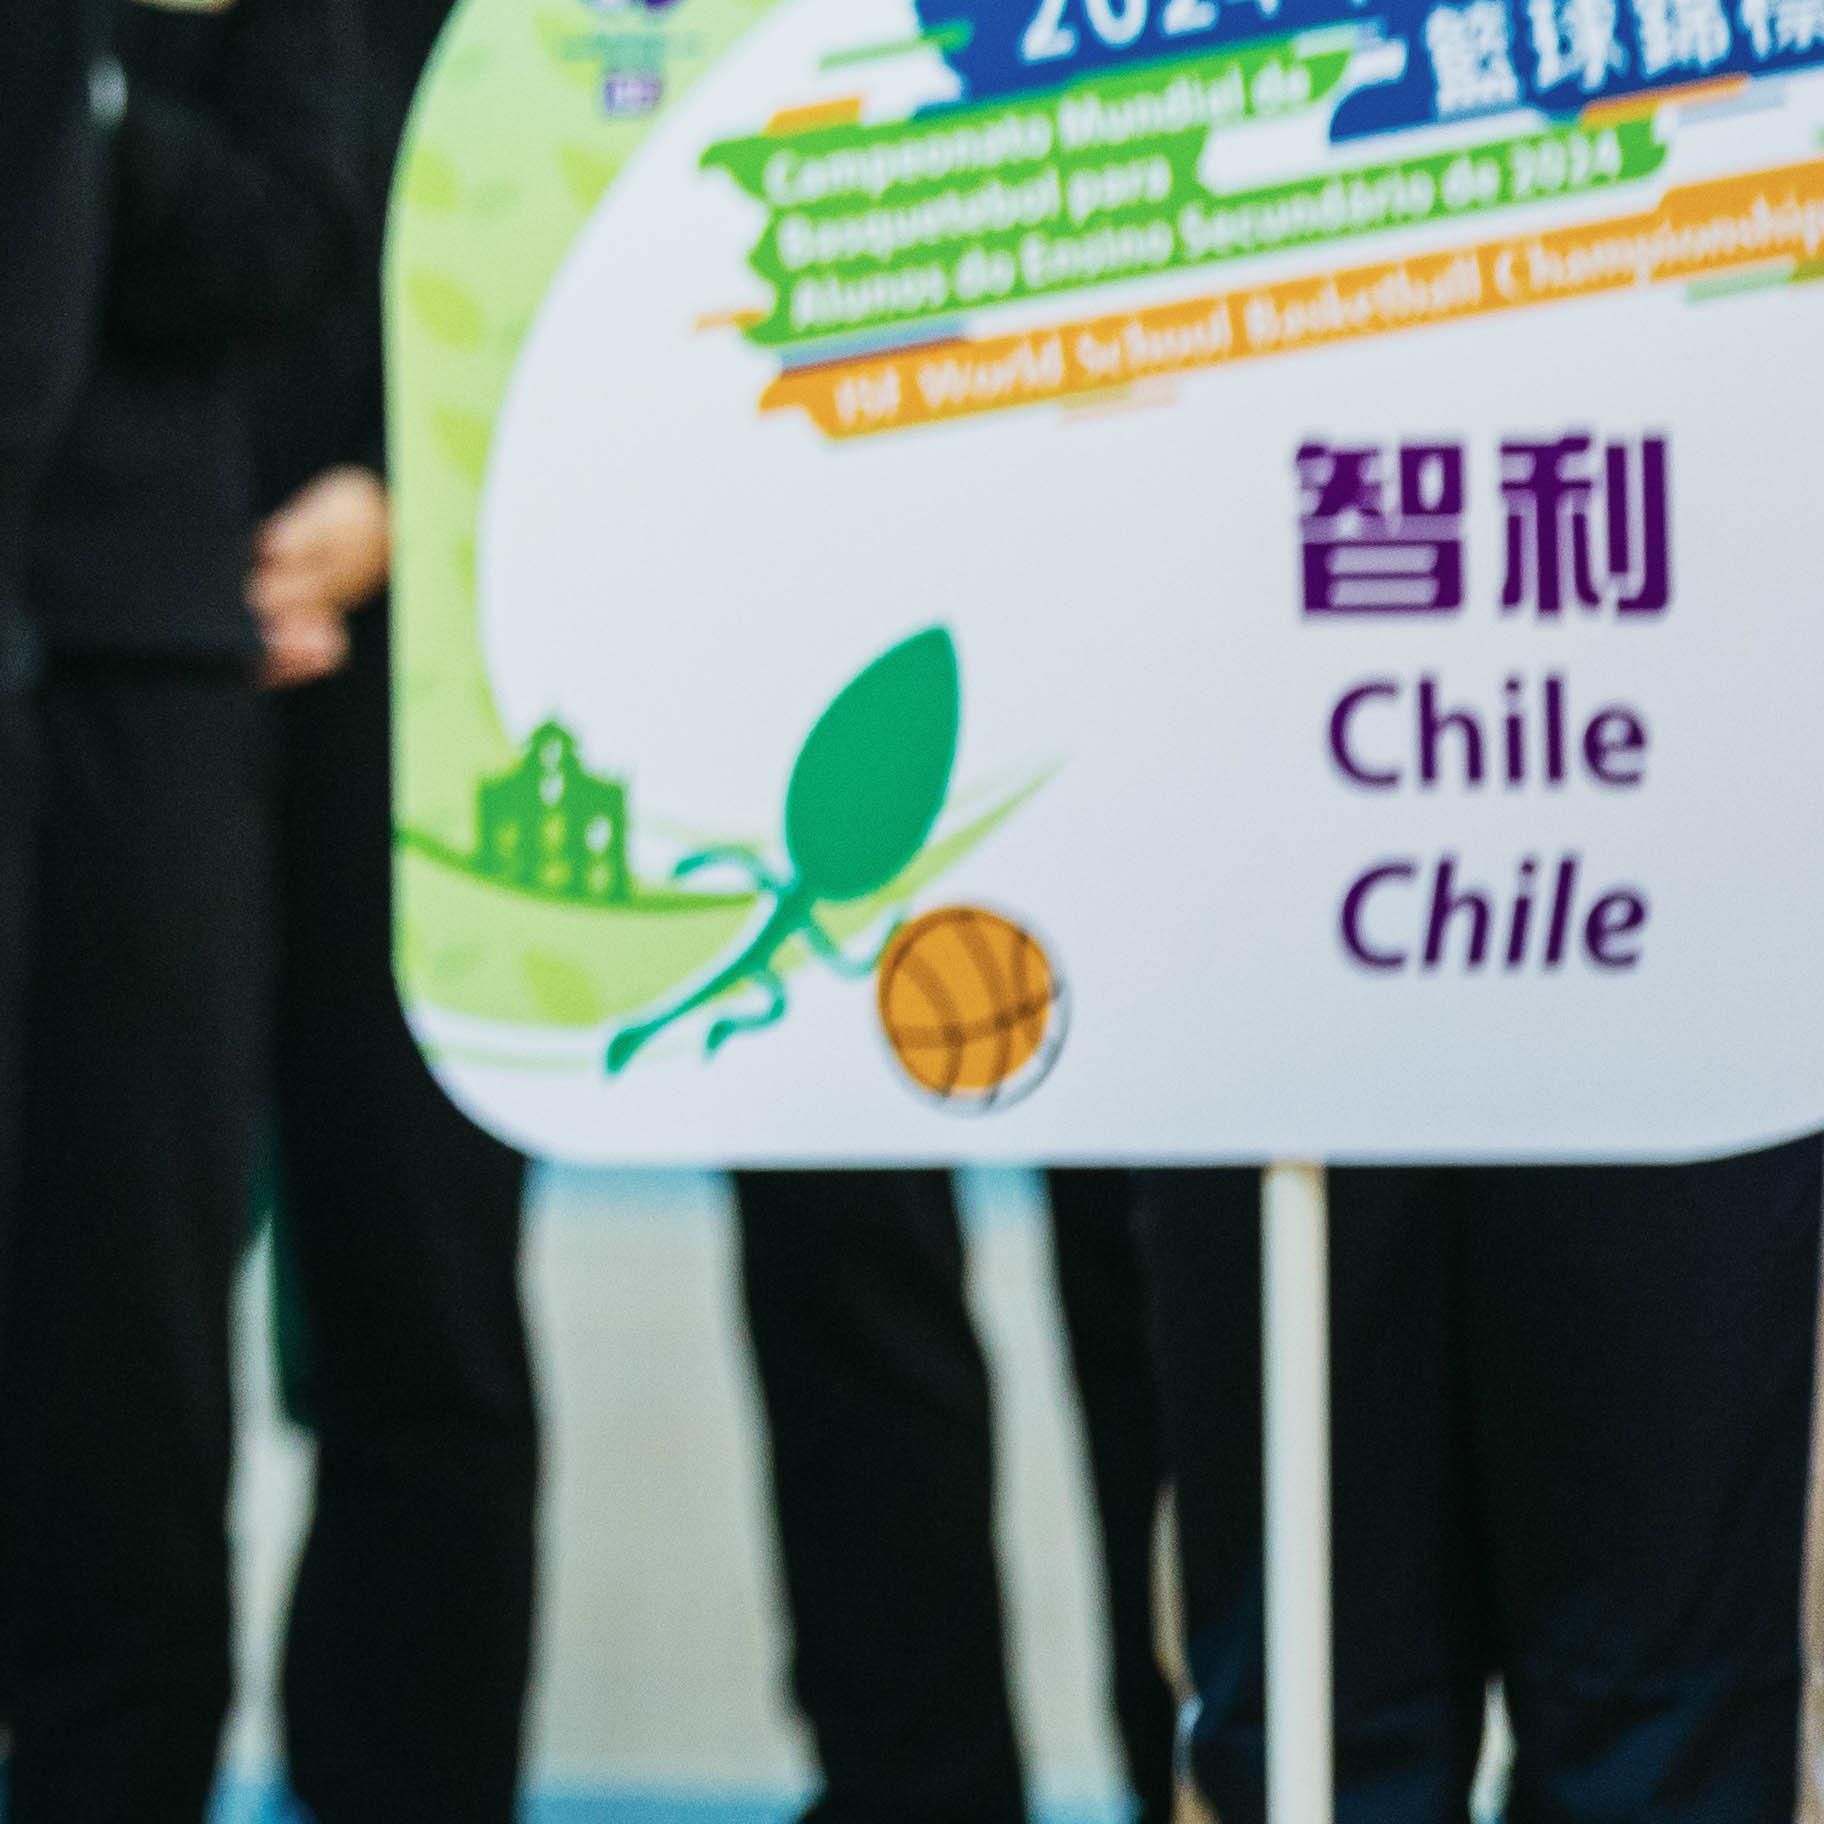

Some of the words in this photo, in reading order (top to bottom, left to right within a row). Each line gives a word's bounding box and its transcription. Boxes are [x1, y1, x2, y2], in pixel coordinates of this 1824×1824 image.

[1298, 436, 1672, 616] 智利
[1328, 678, 1650, 790] Chile
[1338, 858, 1650, 974] Chile
